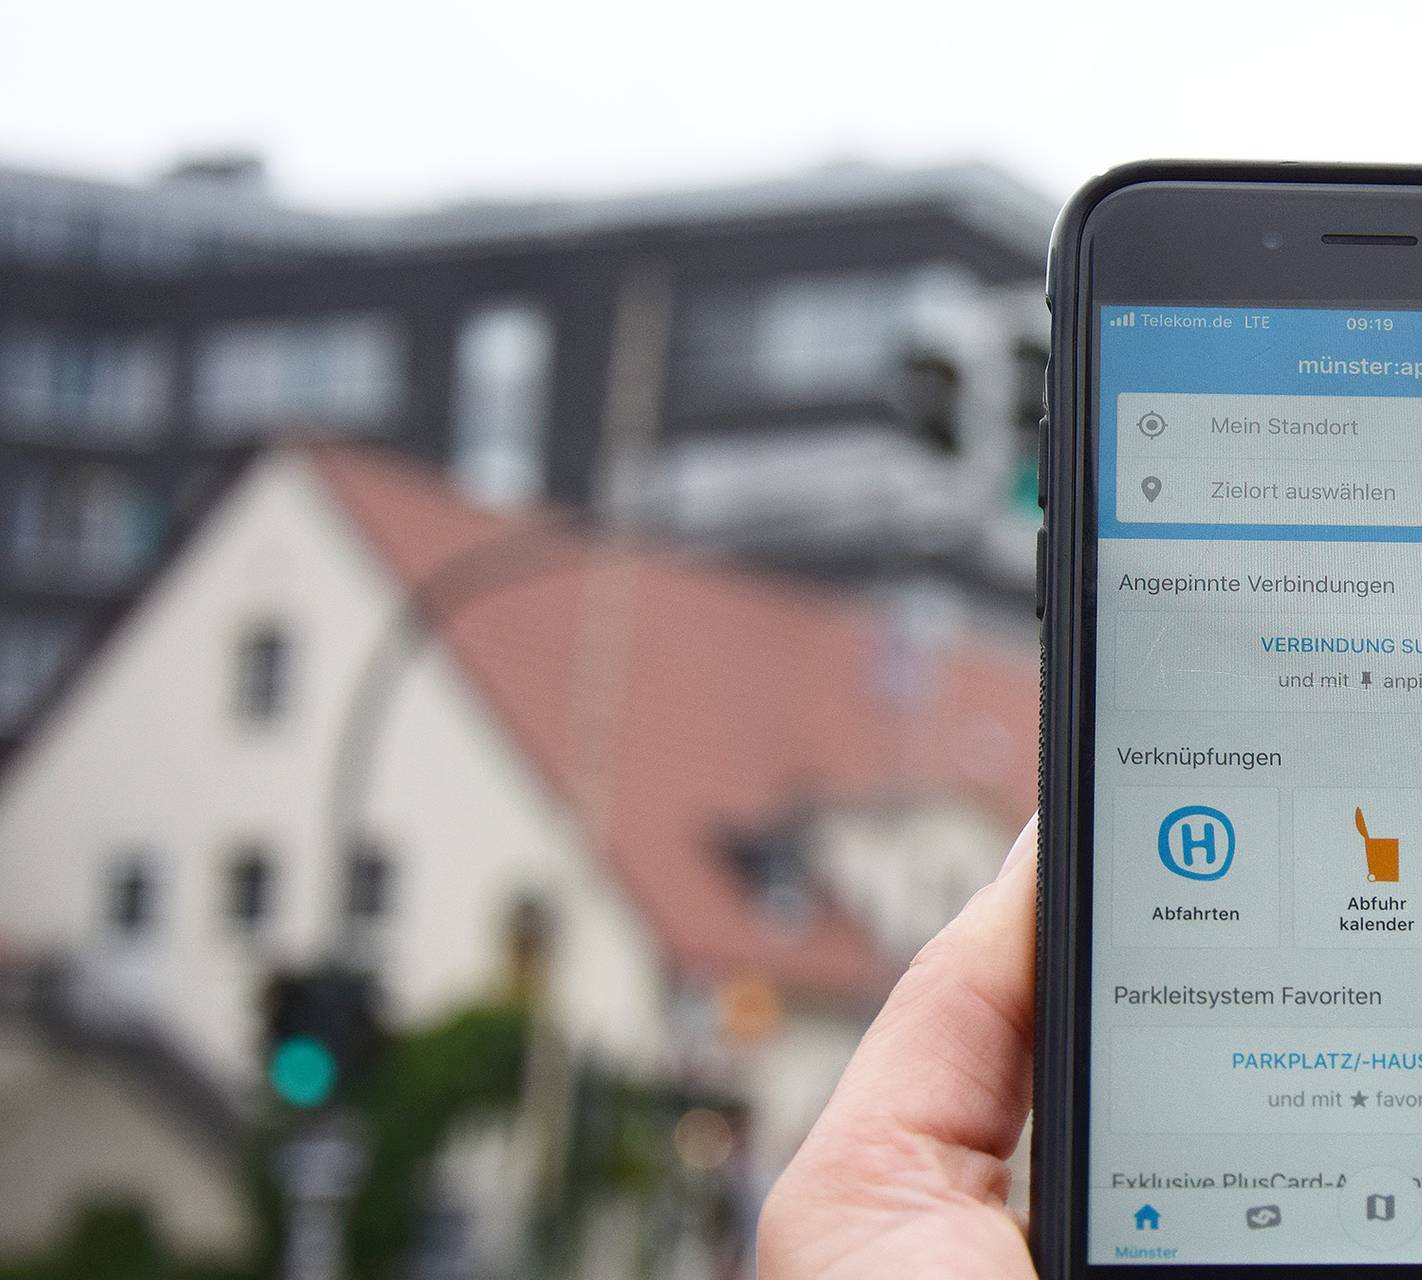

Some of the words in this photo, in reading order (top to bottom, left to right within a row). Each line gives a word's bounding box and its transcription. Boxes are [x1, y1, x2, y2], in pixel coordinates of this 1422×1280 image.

[1141, 313, 1233, 329] Telekom.de
[1244, 316, 1271, 329] LTE
[1346, 317, 1394, 331] 09:19
[1211, 417, 1262, 436] Mein
[1268, 418, 1359, 437] Standort
[1210, 481, 1279, 500] Zielort
[1285, 483, 1396, 502] auswählen
[1118, 573, 1241, 595] Angepinnte
[1248, 574, 1396, 598] Verbindungen
[1261, 636, 1395, 655] VERBINDUNG
[1278, 672, 1314, 690] und
[1320, 672, 1350, 690] mit
[1117, 746, 1282, 770] Verknüpfungen
[1347, 896, 1406, 911] Abfuhr
[1152, 906, 1240, 922] Abfahrten
[1339, 915, 1414, 932] kalender
[1113, 986, 1275, 1010] Parkleitsystem
[1281, 986, 1382, 1006] Favoriten
[1268, 1090, 1305, 1108] und
[1311, 1090, 1342, 1108] mit
[1114, 1246, 1177, 1259] Münster
